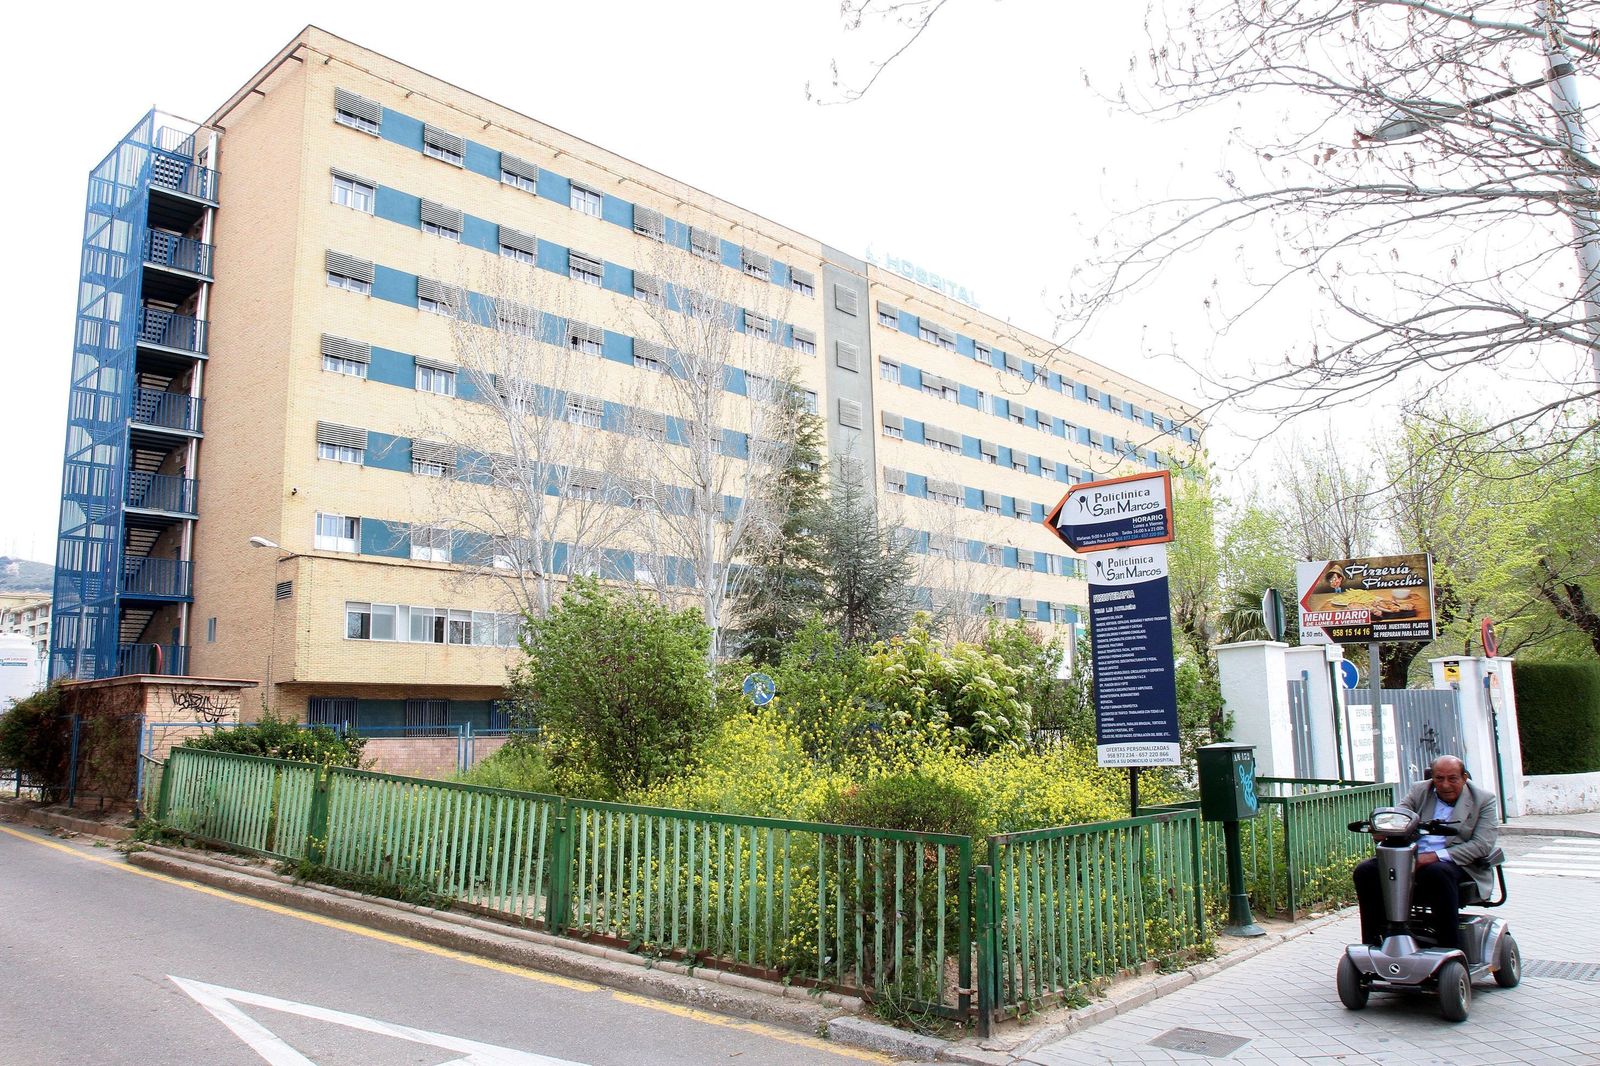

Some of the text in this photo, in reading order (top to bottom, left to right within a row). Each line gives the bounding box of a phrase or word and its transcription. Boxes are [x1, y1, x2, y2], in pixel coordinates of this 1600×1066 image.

[1092, 500, 1160, 517] San Marcos
[1132, 514, 1164, 524] HORARIO
[1106, 566, 1161, 581] San Marcos
[1345, 562, 1411, 579] Pizzería
[1362, 576, 1425, 589] Pinocchio
[1304, 610, 1368, 622] MENU DIARIO
[1332, 628, 1370, 637] 958 15 14 16
